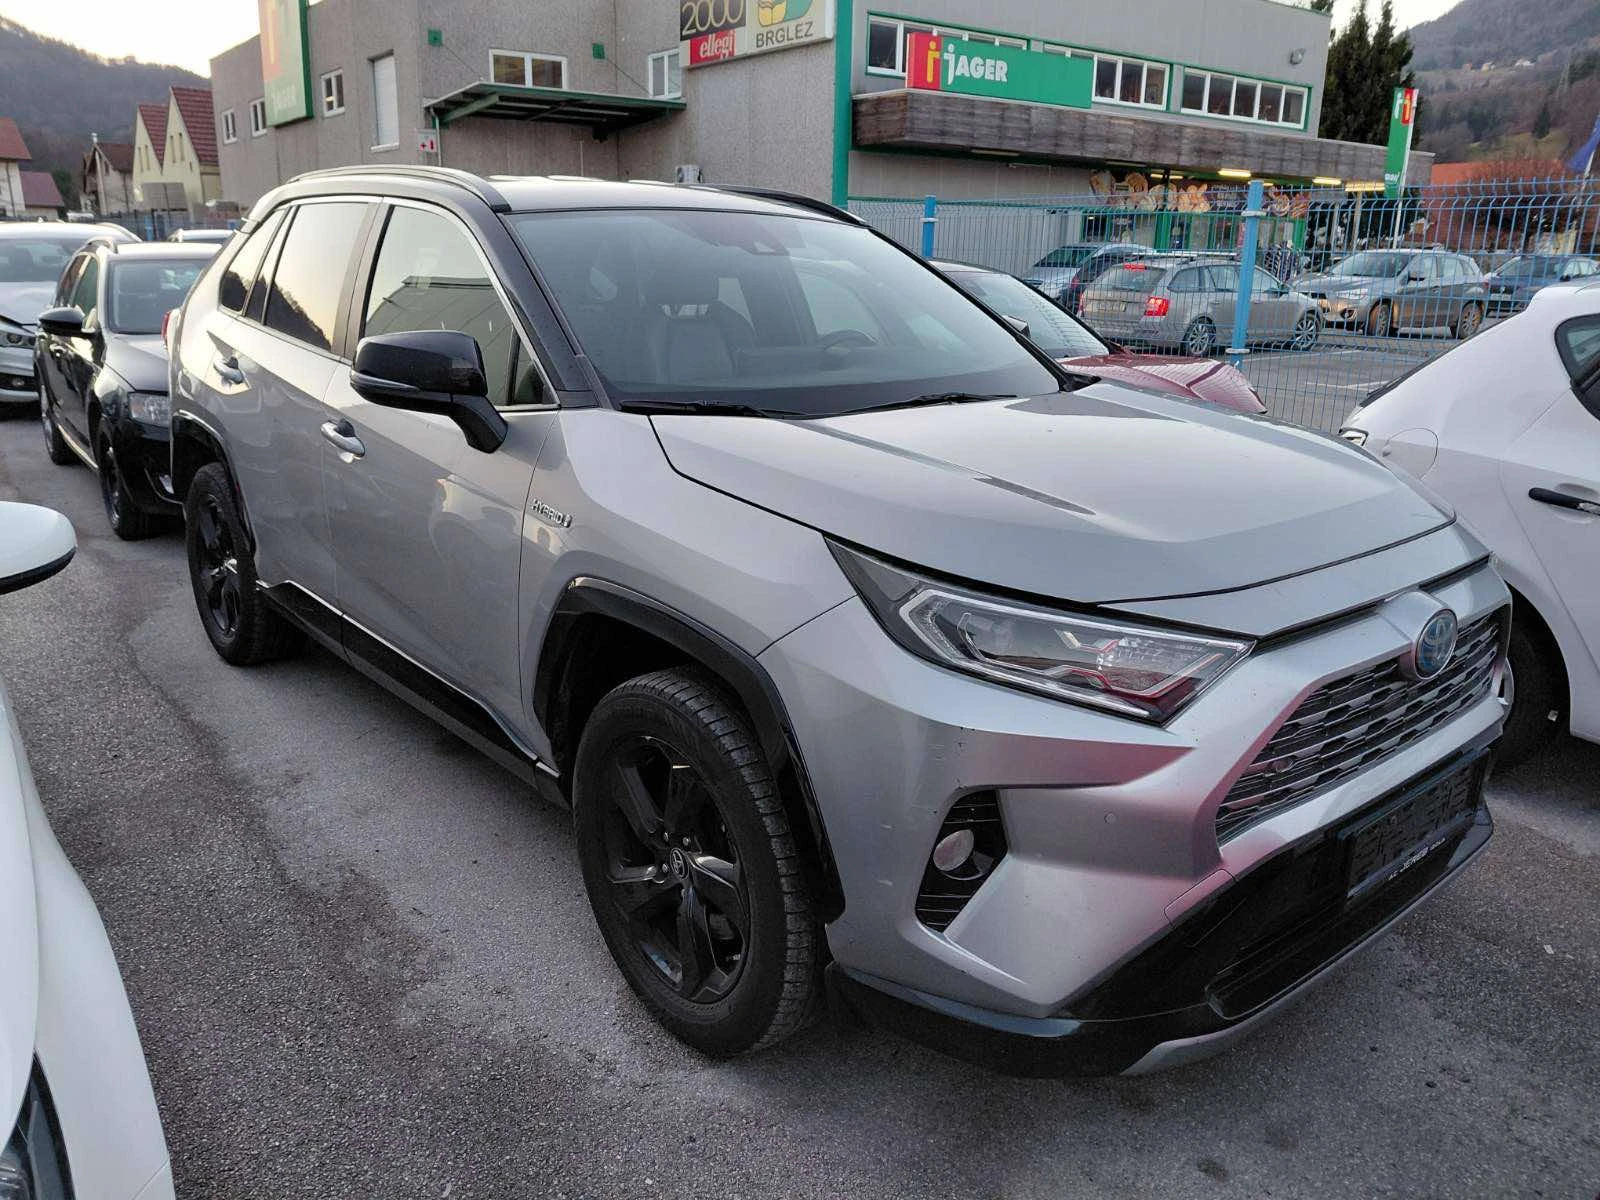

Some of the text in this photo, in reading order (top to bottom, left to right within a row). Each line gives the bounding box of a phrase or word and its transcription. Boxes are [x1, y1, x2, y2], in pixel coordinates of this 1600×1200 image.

[682, 0, 743, 36] 2000
[700, 30, 733, 59] ellegi
[756, 21, 813, 48] BRGLEZ
[531, 499, 564, 524] HYBRID
